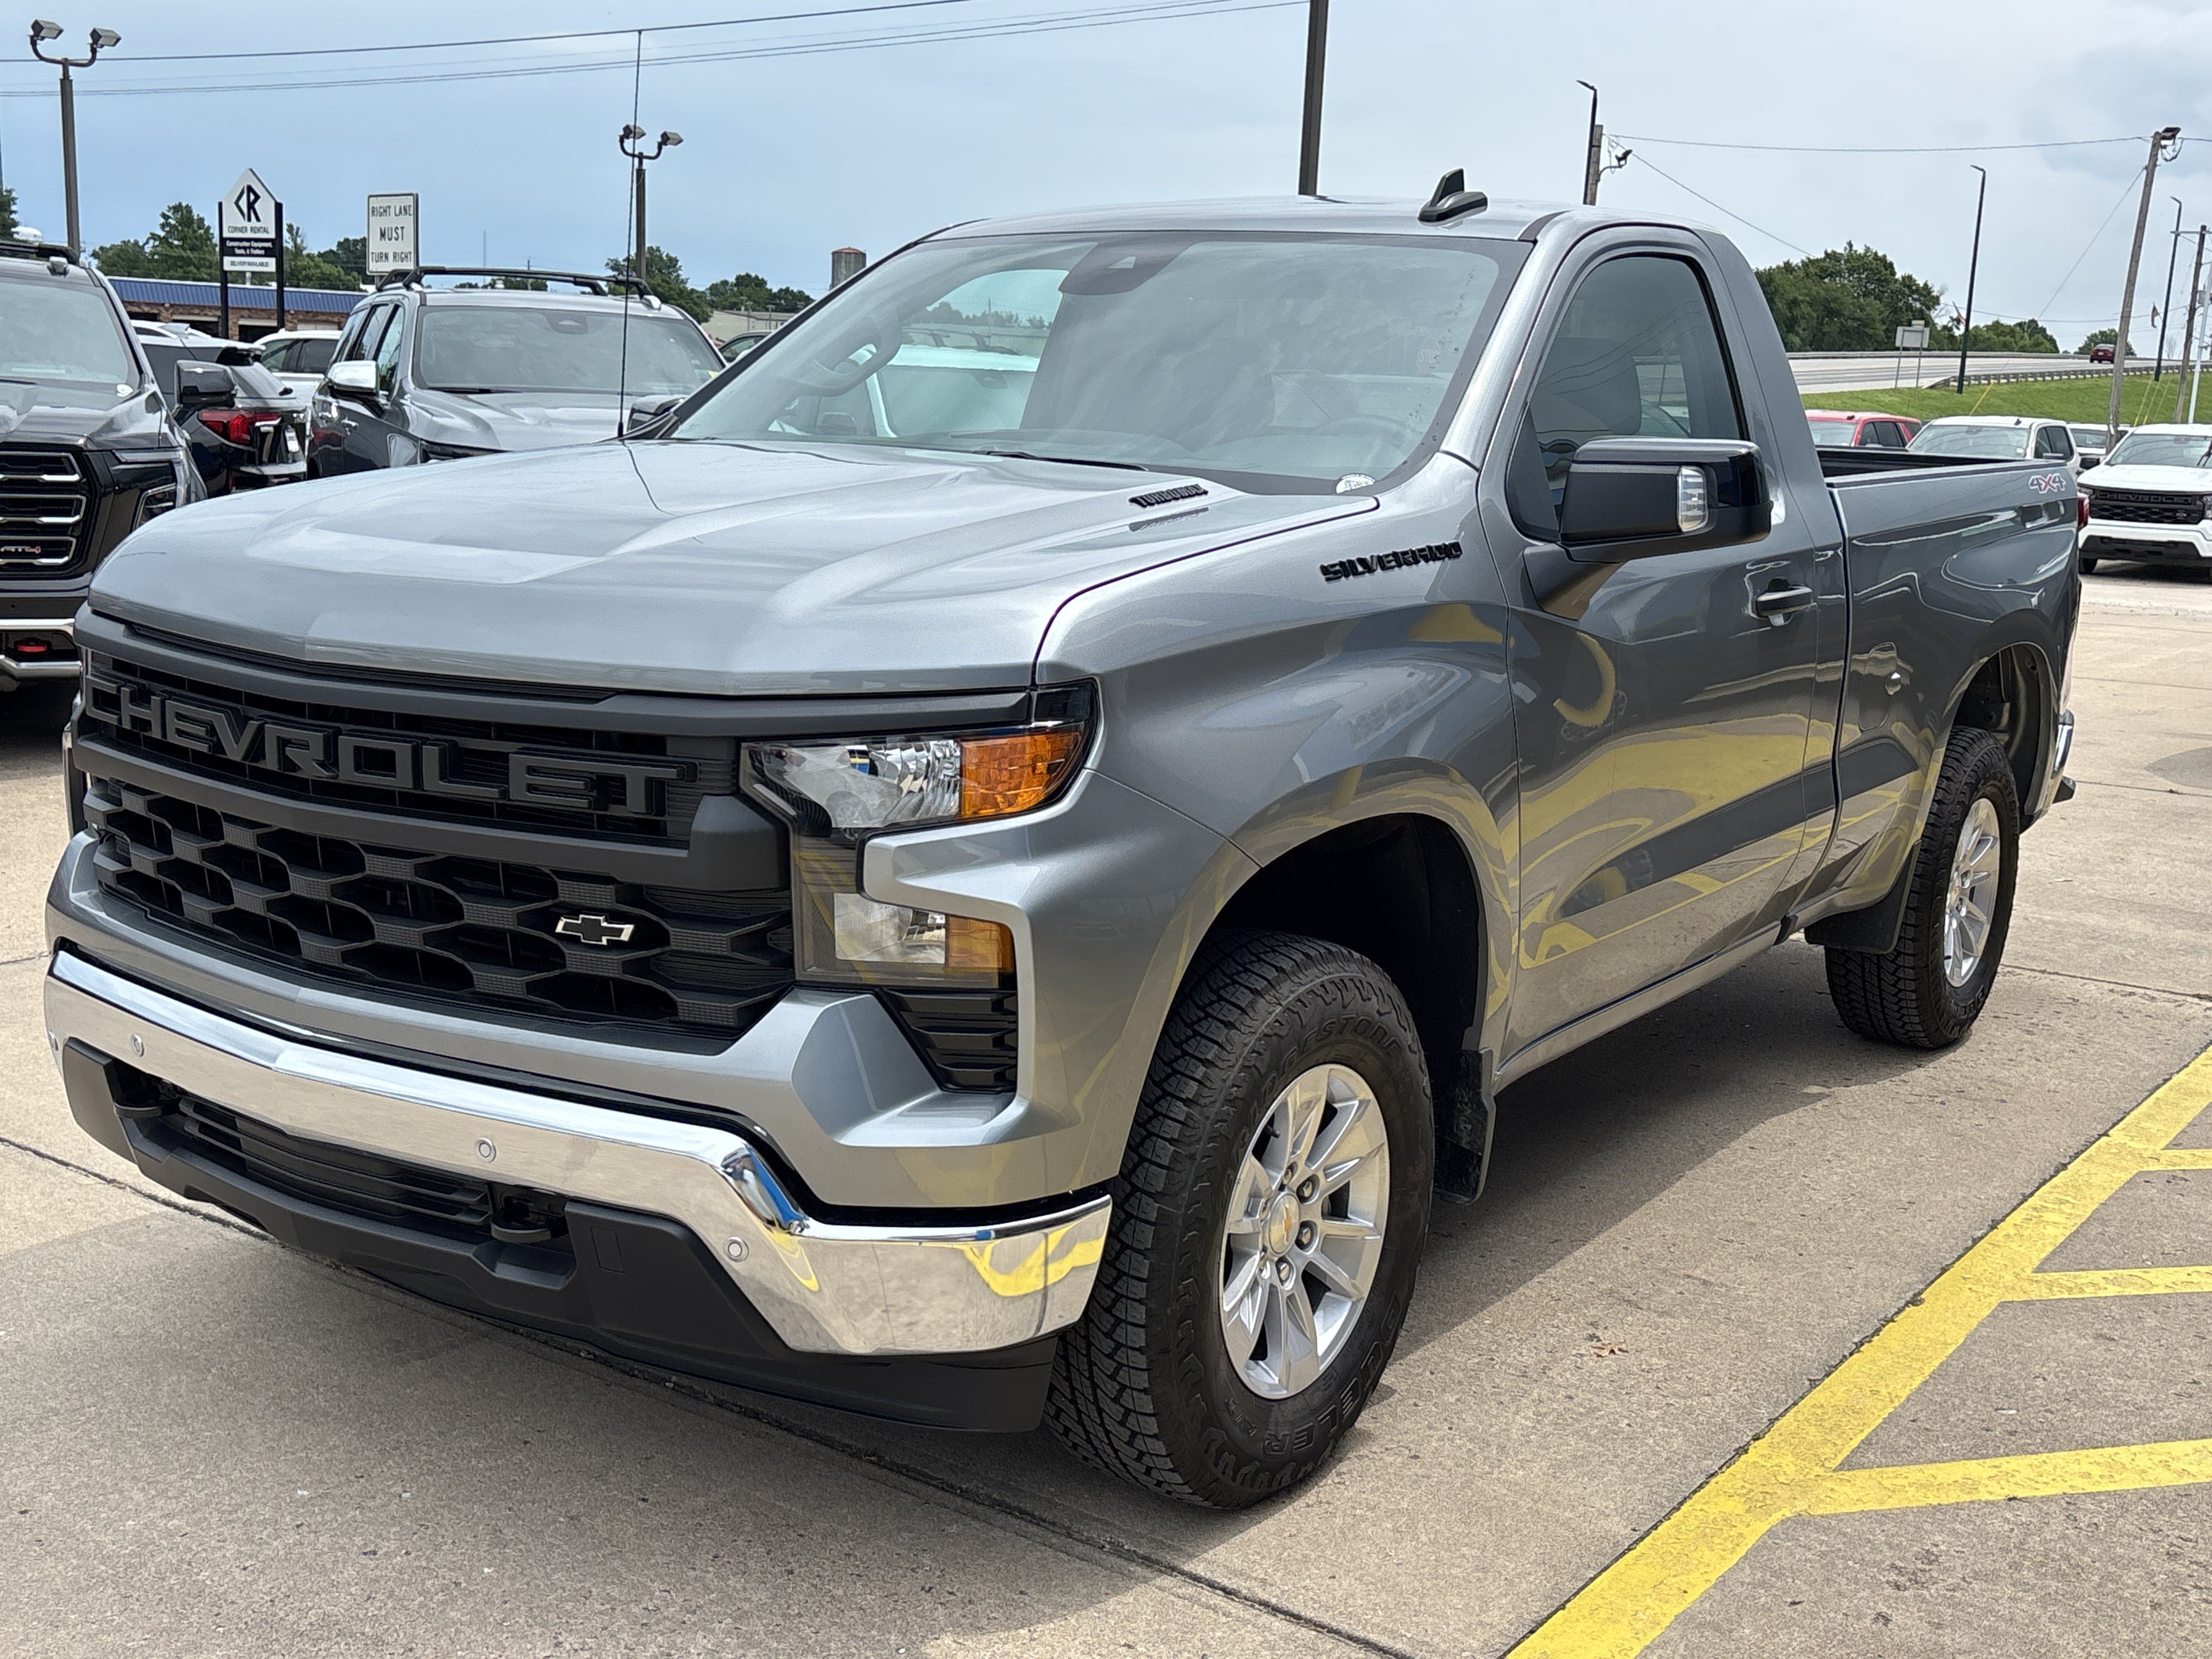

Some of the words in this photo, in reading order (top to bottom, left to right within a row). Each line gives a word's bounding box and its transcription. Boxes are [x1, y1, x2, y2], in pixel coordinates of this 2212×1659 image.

[371, 205, 391, 218] RIGHT
[394, 205, 413, 217] LANE
[250, 226, 269, 234] RENTAL
[380, 226, 405, 241] MUST
[371, 251, 389, 263] TURN
[393, 251, 413, 263] RIGHT
[1128, 484, 1209, 508] TURBOMAX
[2097, 493, 2192, 504] CHEVROLET
[1319, 541, 1463, 583] SILVERADO
[84, 677, 698, 816] CHEVROLET
[1264, 1289, 1402, 1454] DUELER
